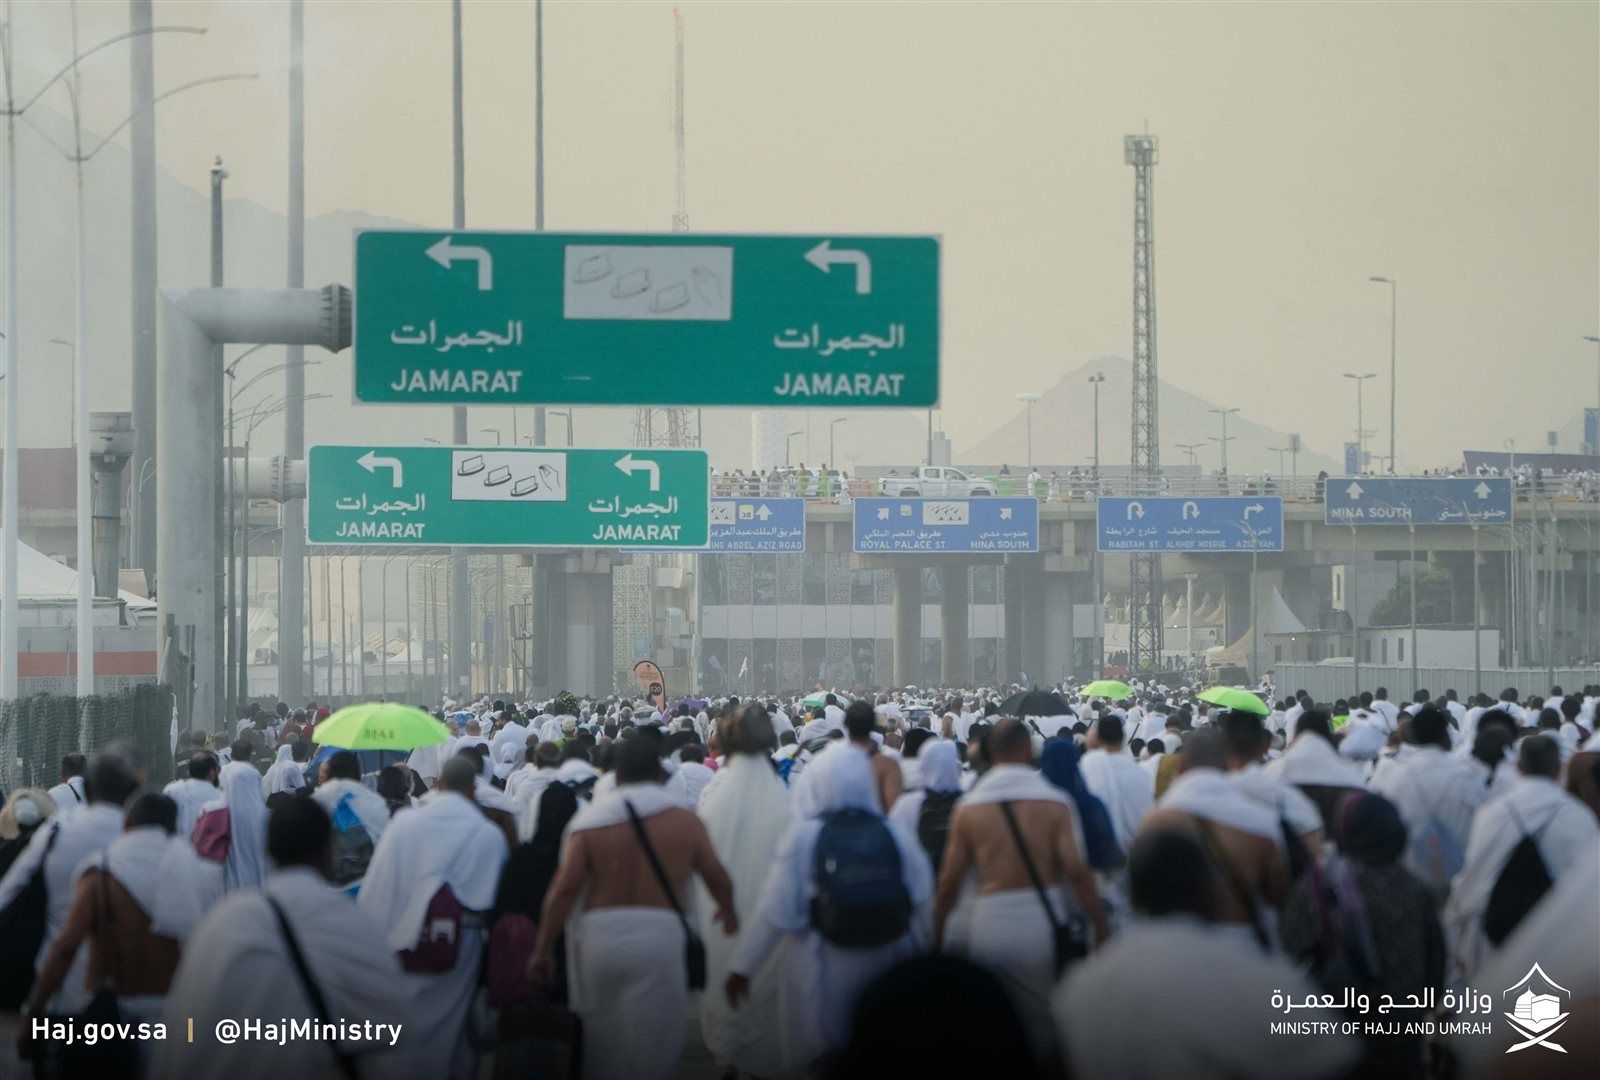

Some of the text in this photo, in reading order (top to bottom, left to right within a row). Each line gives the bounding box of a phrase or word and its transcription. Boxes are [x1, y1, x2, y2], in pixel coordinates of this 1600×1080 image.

[390, 319, 522, 352] الجمرات
[773, 323, 905, 356] الجمرات
[390, 369, 522, 393] JAMARAT
[774, 373, 904, 397] JAMARAT
[335, 493, 426, 516] الجمرات
[588, 497, 678, 518] الجمرات
[1331, 507, 1412, 519] MINA SOUTH
[335, 522, 425, 539] JAMARAT
[592, 524, 681, 541] JAMARAT
[711, 541, 802, 550] ING ABDEL AZIZ ROAD
[860, 540, 891, 549] ROYAL
[894, 540, 932, 550] PALACE
[970, 540, 1029, 549] MINA SOUTH
[1108, 540, 1145, 549] RABITAH
